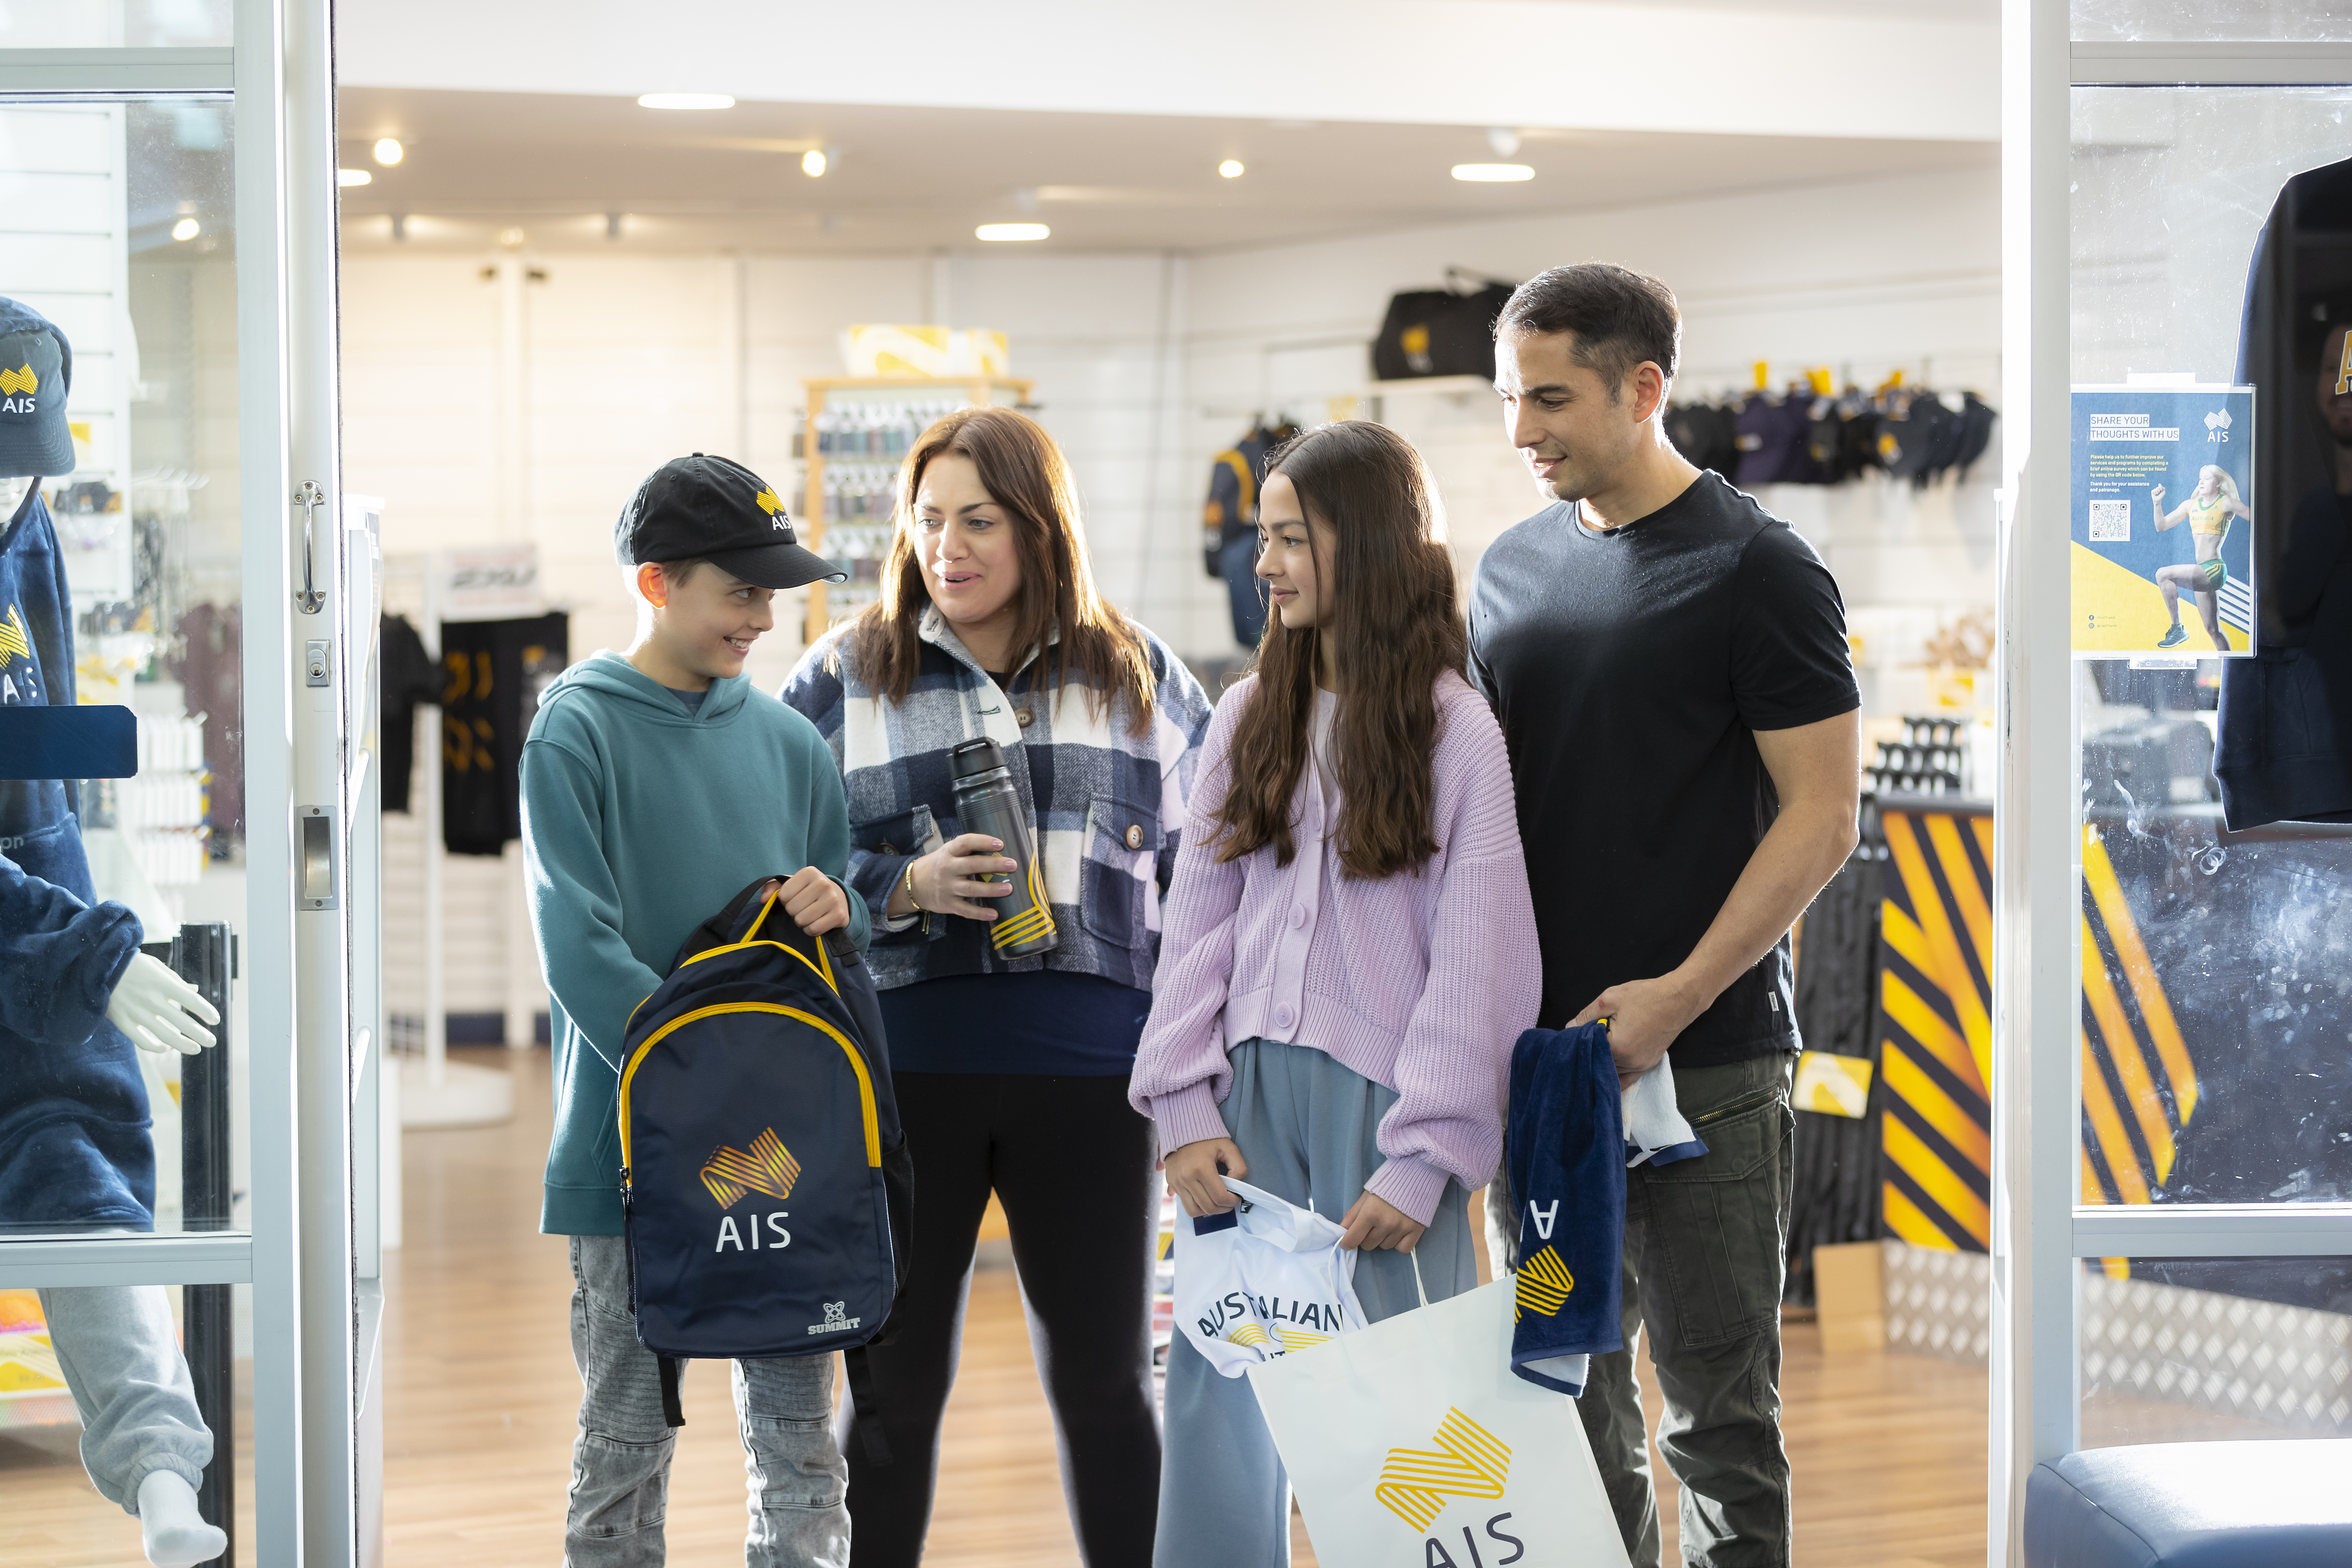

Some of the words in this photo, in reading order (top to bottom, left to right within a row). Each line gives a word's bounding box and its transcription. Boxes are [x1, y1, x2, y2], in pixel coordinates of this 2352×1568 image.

[2, 398, 36, 413] AIS
[2207, 431, 2229, 442] AIS
[772, 515, 791, 530] AIS
[716, 1212, 791, 1253] AIS
[1197, 1291, 1344, 1337] AUSTALIAN
[808, 1317, 861, 1335] SUMMIT
[1425, 1512, 1524, 1568] AIS
